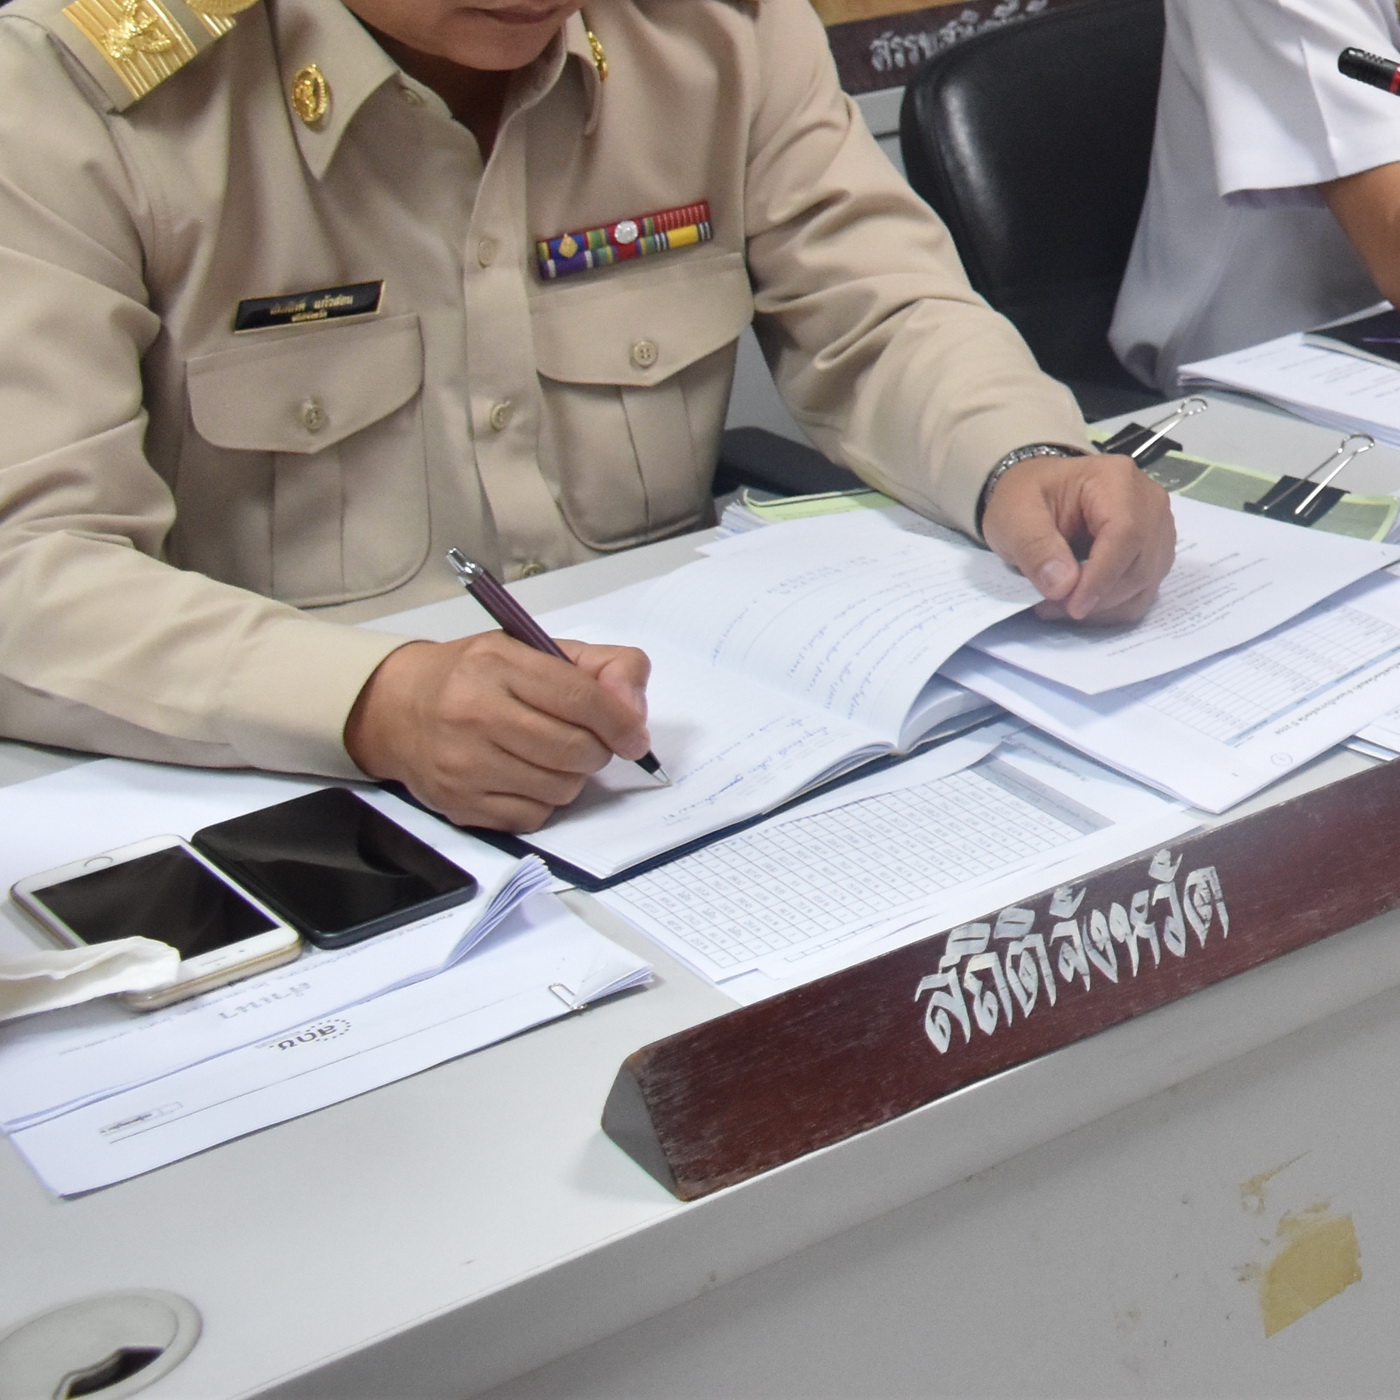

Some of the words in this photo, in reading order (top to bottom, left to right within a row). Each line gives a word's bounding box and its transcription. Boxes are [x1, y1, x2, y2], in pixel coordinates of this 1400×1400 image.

[914, 848, 1229, 1055] สถิติจังหวัด
